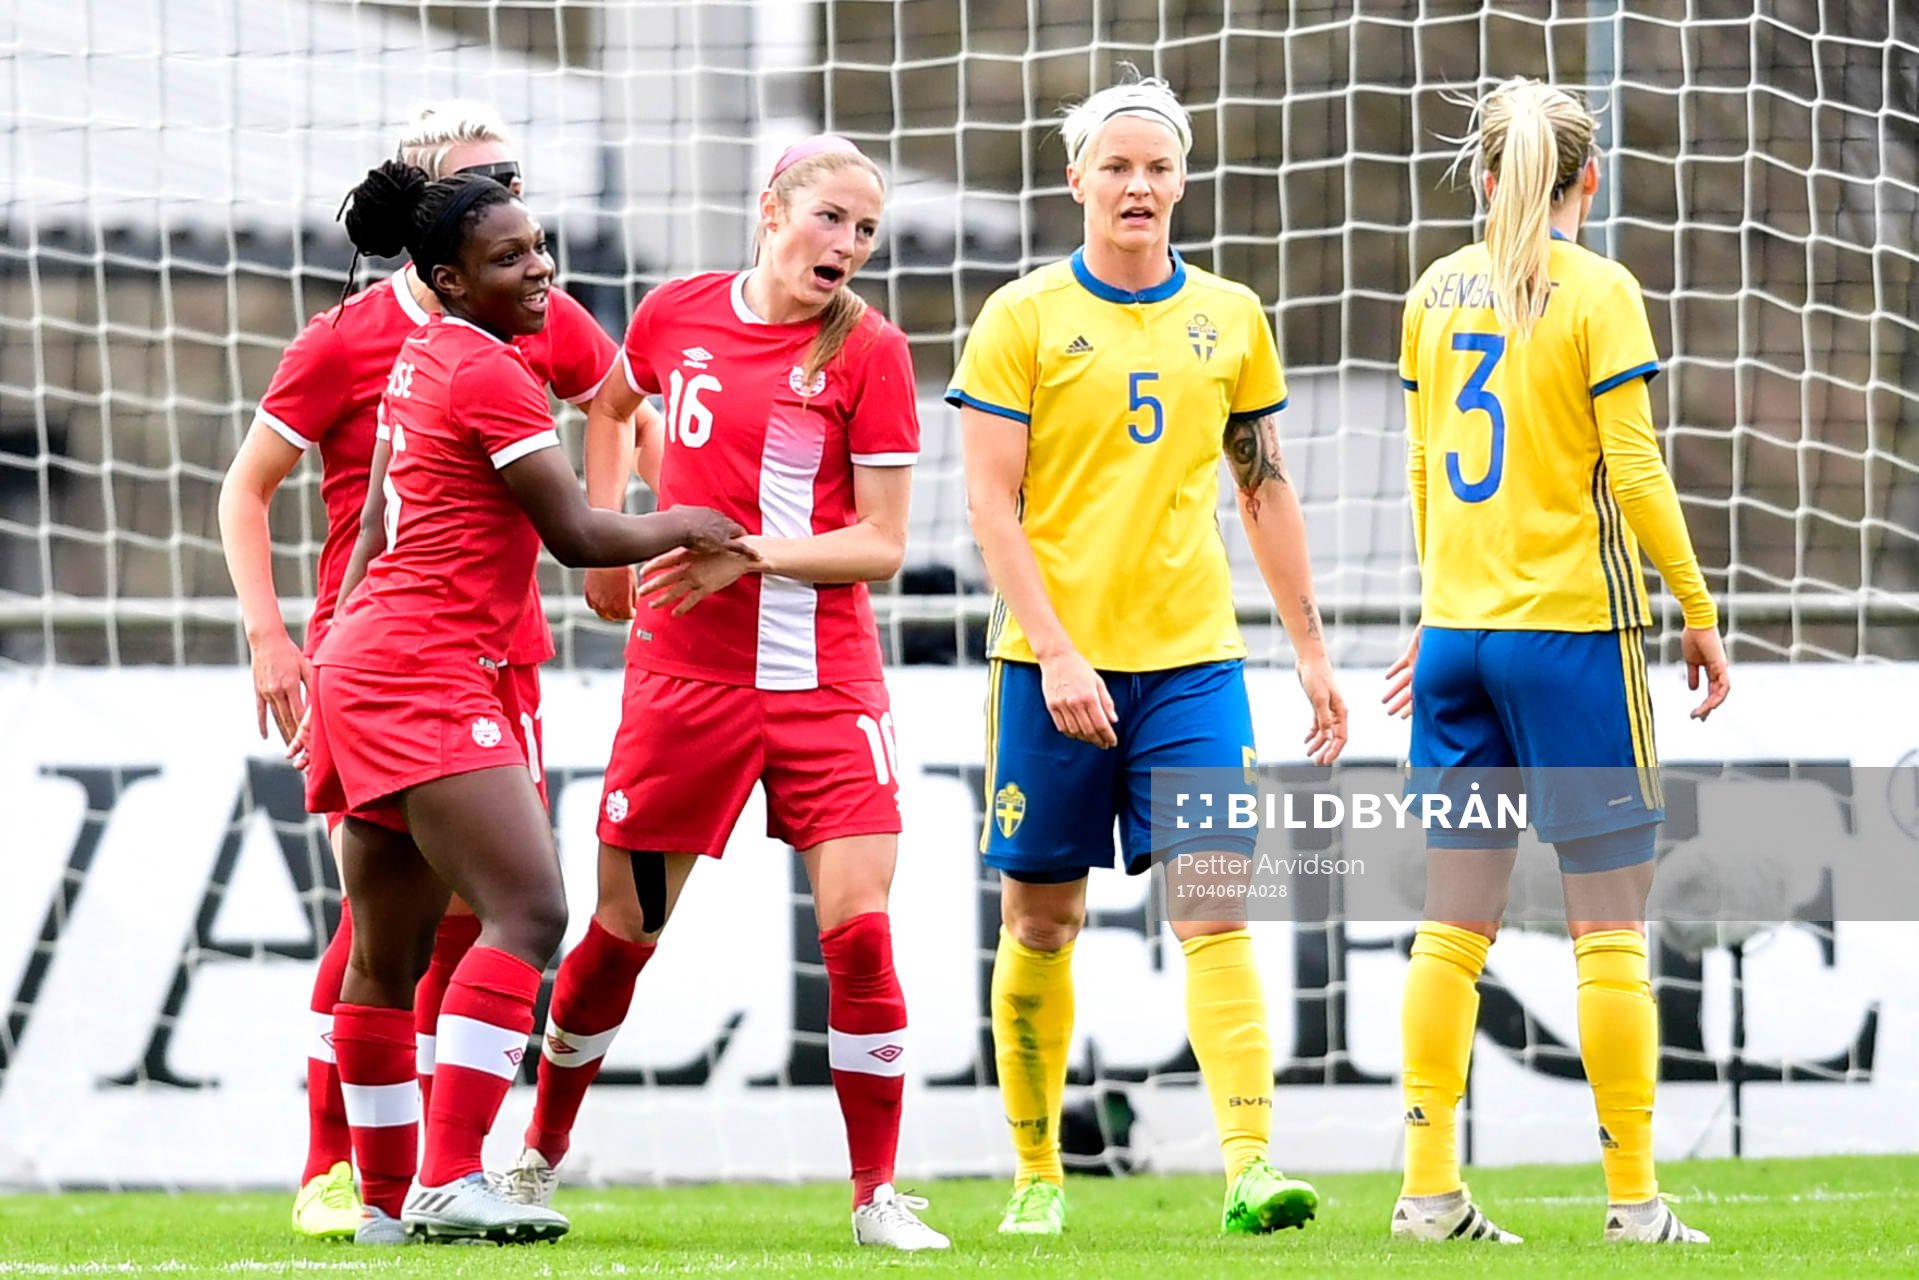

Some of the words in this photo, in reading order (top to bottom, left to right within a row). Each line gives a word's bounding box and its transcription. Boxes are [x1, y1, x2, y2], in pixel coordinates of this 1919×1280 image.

[1425, 272, 1560, 318] SEMBRT
[387, 361, 415, 398] SE
[668, 368, 722, 448] 16
[1128, 372, 1163, 444] 5
[1445, 333, 1505, 503] 3
